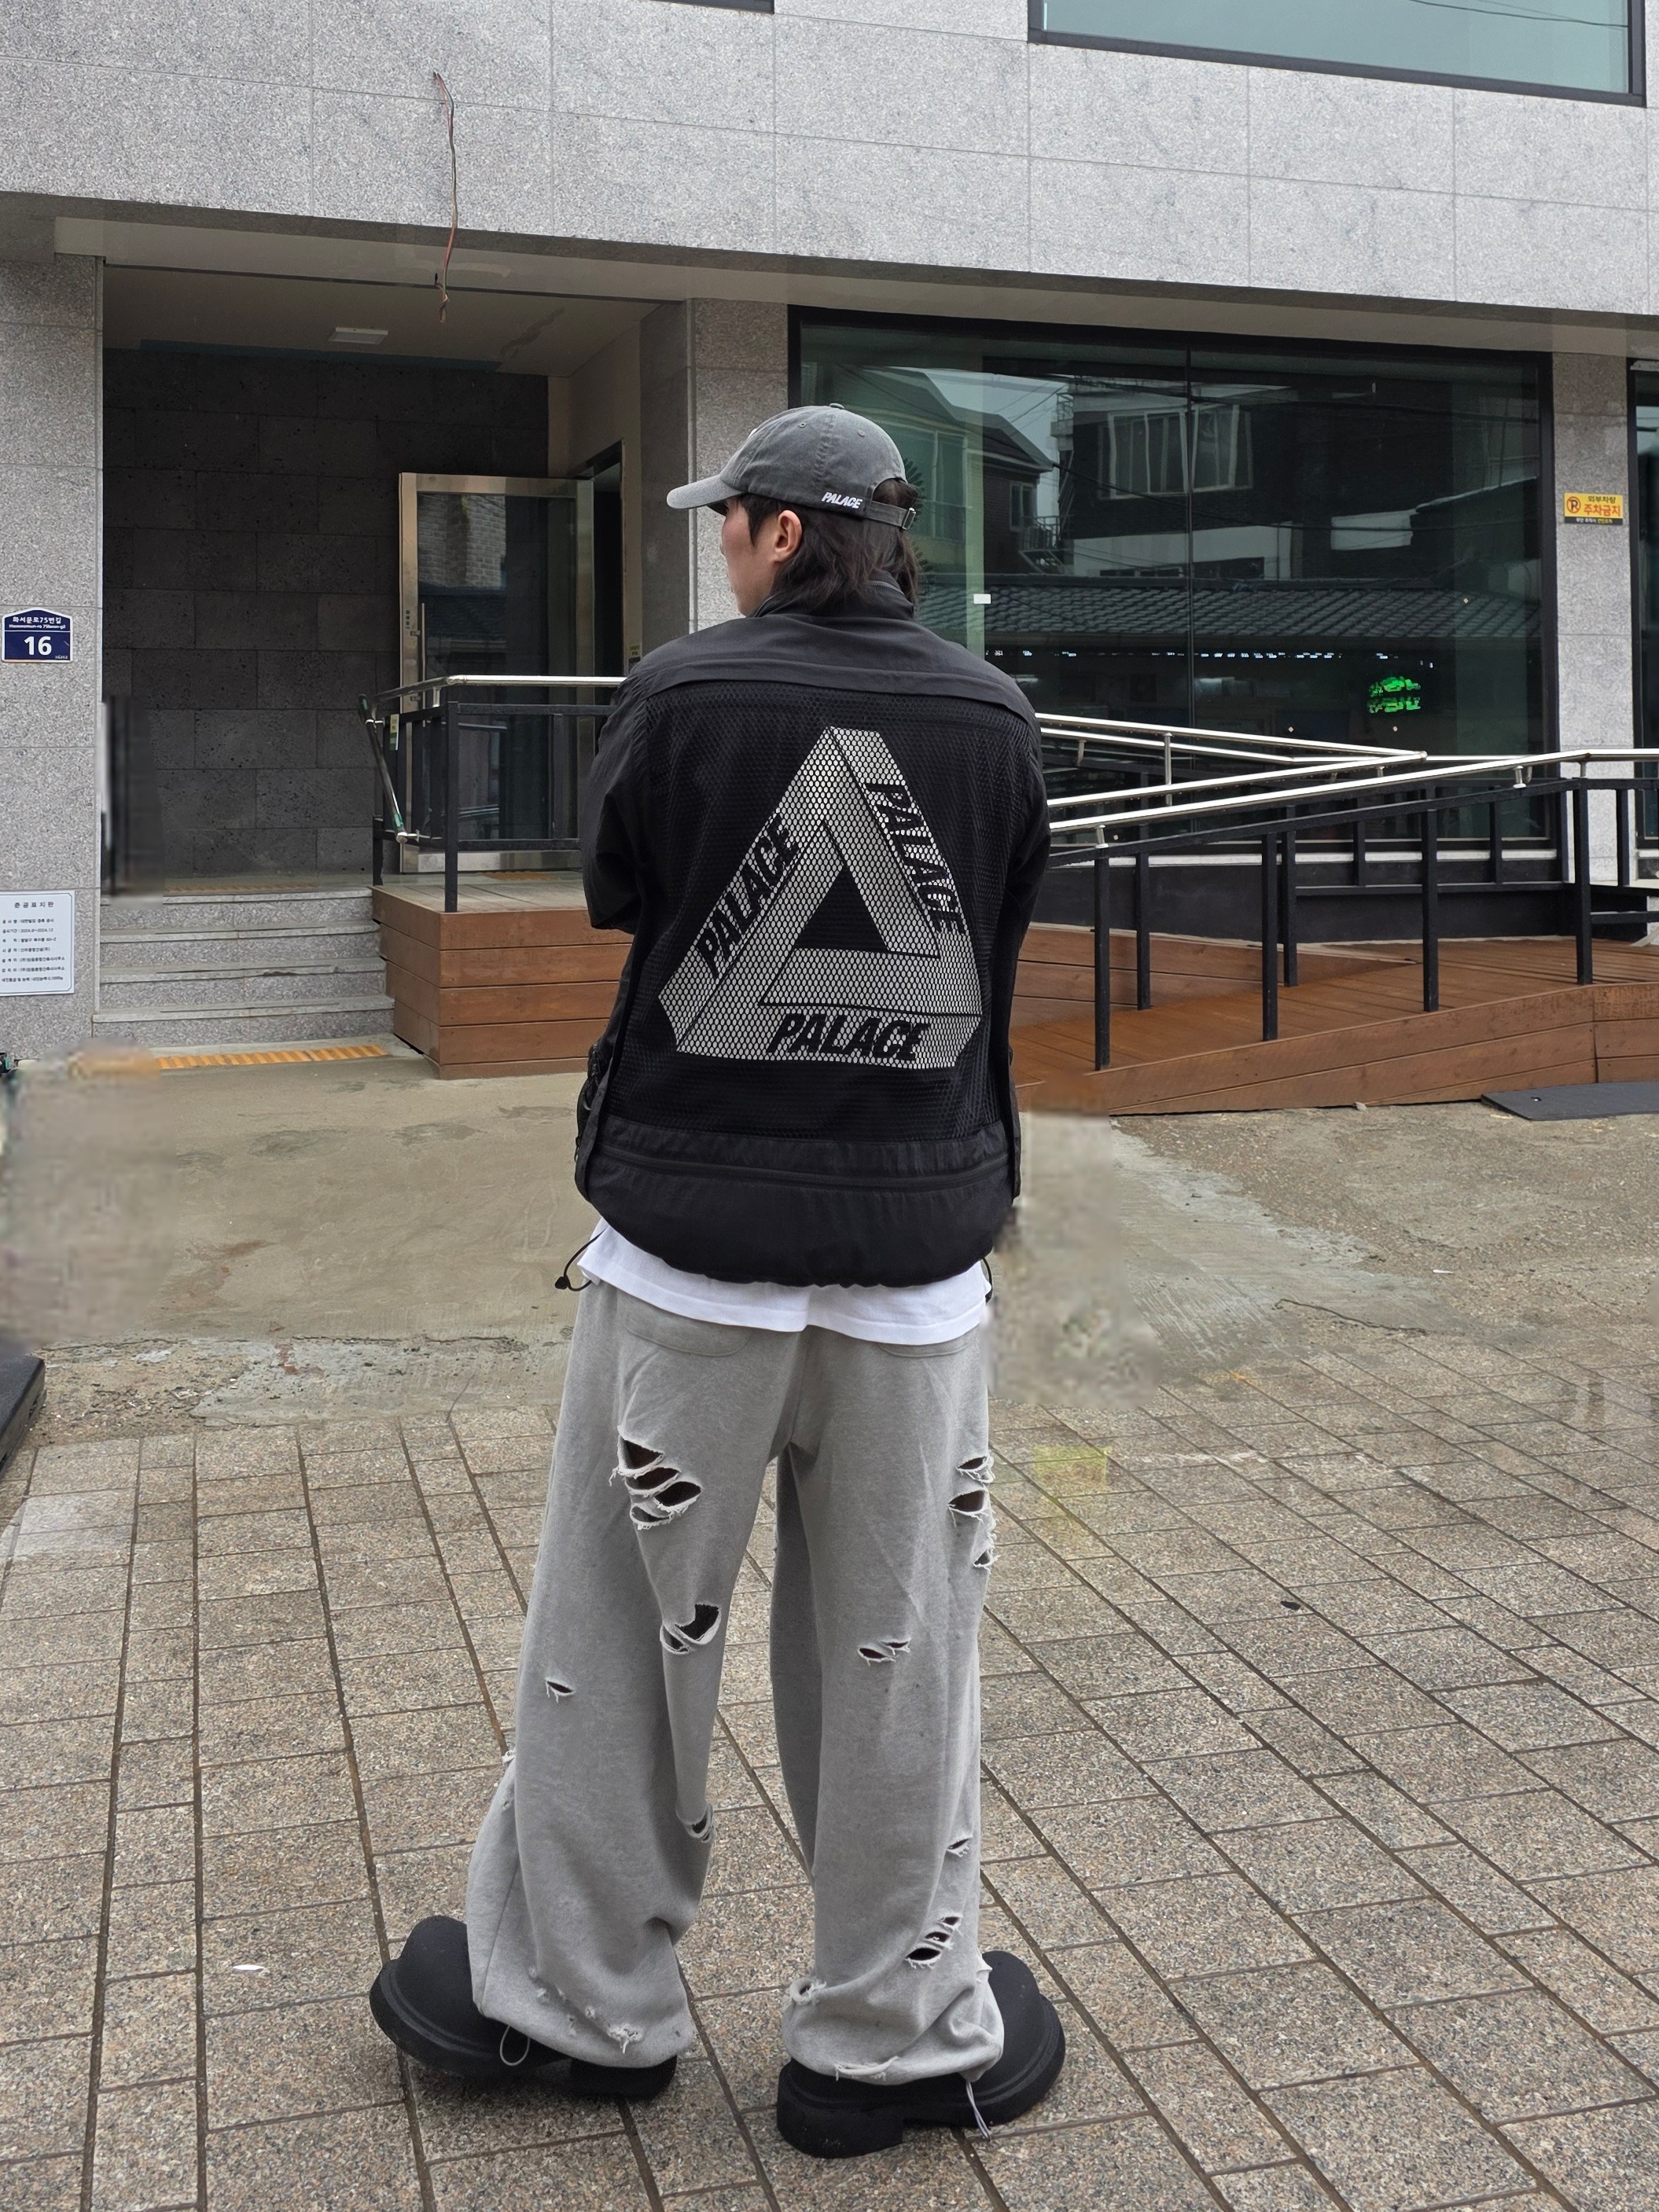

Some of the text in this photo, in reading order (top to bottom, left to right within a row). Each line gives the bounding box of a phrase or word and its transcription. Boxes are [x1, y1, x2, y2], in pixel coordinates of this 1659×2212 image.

[821, 491, 863, 509] PALACE
[1584, 504, 1621, 516] 주차금지
[24, 635, 52, 656] 16
[866, 783, 969, 935] PALACE
[693, 812, 799, 979] PALACE
[764, 1013, 930, 1063] PALACE
